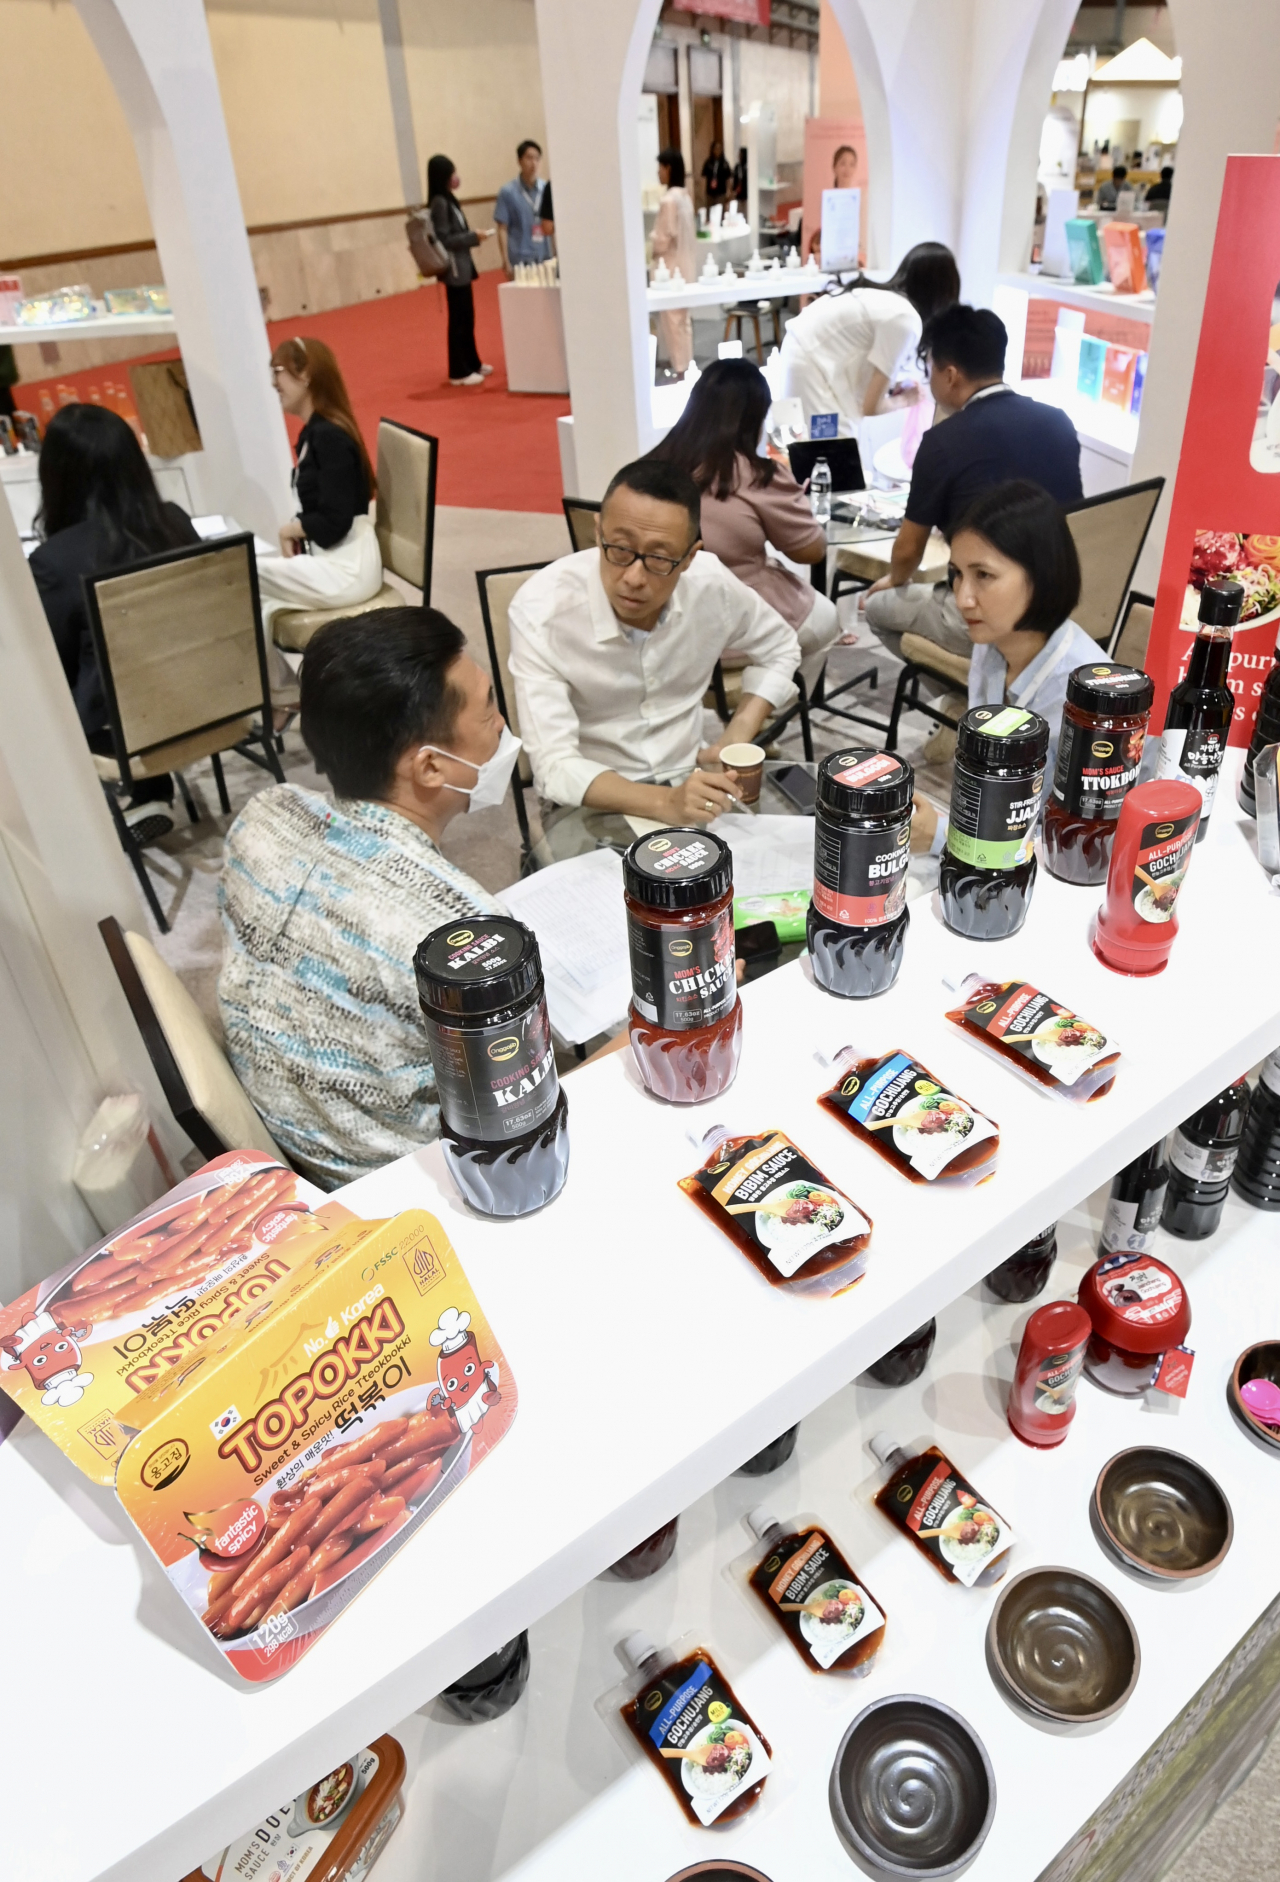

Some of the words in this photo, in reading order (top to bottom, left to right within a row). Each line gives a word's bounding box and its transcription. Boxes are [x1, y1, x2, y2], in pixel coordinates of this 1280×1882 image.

[1082, 767, 1104, 775] MOM'S
[1105, 764, 1124, 775] SAUCE
[653, 841, 706, 870] CHICKEN
[679, 848, 709, 867] SAUCE
[875, 846, 906, 863] COOKING
[447, 933, 506, 970] KALBI
[481, 956, 502, 969] 500g
[674, 965, 701, 980] MOM'S
[998, 992, 1033, 1028] ALL-PURPOSE
[1009, 994, 1050, 1033] GOCHUJANG
[490, 1041, 517, 1055] Onggojib
[490, 1064, 530, 1090] COOKING
[859, 1067, 899, 1111] ALL-PURPOSE
[871, 1068, 918, 1117] GOCHUJANG
[505, 1112, 533, 1126] 17.63oz
[722, 1169, 749, 1195] HONEY
[734, 1168, 770, 1201] BIBIM
[762, 1148, 798, 1176] SAUCE
[261, 1211, 287, 1234] spicy
[262, 1213, 298, 1242] fantastic
[373, 1246, 399, 1271] FSSC
[398, 1224, 425, 1251] 22000
[237, 1252, 270, 1279] Sweet
[418, 1268, 440, 1286] HALAL
[199, 1286, 230, 1310] Spicy
[112, 1295, 197, 1360] 떡볶이
[177, 1309, 201, 1328] Rice
[303, 1335, 330, 1359] No.
[340, 1283, 385, 1326] Korea
[115, 1326, 178, 1377] Tteokbokki
[218, 1296, 406, 1474] TOPOKKI
[334, 1355, 412, 1434] 떡볶이
[253, 1449, 291, 1487] Sweet
[291, 1439, 302, 1451] &
[301, 1408, 333, 1441] Spicy
[332, 1388, 356, 1413] Rice
[354, 1334, 412, 1389] Tteokbokki
[150, 1447, 183, 1480] 옹고집
[275, 1458, 305, 1490] 환상의
[304, 1430, 335, 1462] 매운맛!
[913, 1476, 943, 1521] ALL-PURPOSE
[922, 1478, 957, 1527] GOCHUJANG
[214, 1504, 259, 1551] fantastic
[227, 1520, 258, 1555] spicy
[775, 1567, 796, 1593] HONEY
[784, 1570, 810, 1601] BIBIM
[804, 1547, 830, 1575] SAUCE
[252, 1611, 289, 1649] 120g
[263, 1639, 279, 1658] 298
[276, 1622, 294, 1642] kcal
[658, 1685, 698, 1735] ALL-PURPOSE
[666, 1685, 714, 1745] GOCHUJANG
[710, 1703, 724, 1716] MILD
[361, 1757, 376, 1775] 500g
[234, 1840, 260, 1874] MOM'S
[244, 1848, 270, 1881] SAUCE
[299, 1846, 314, 1865] KOREA
